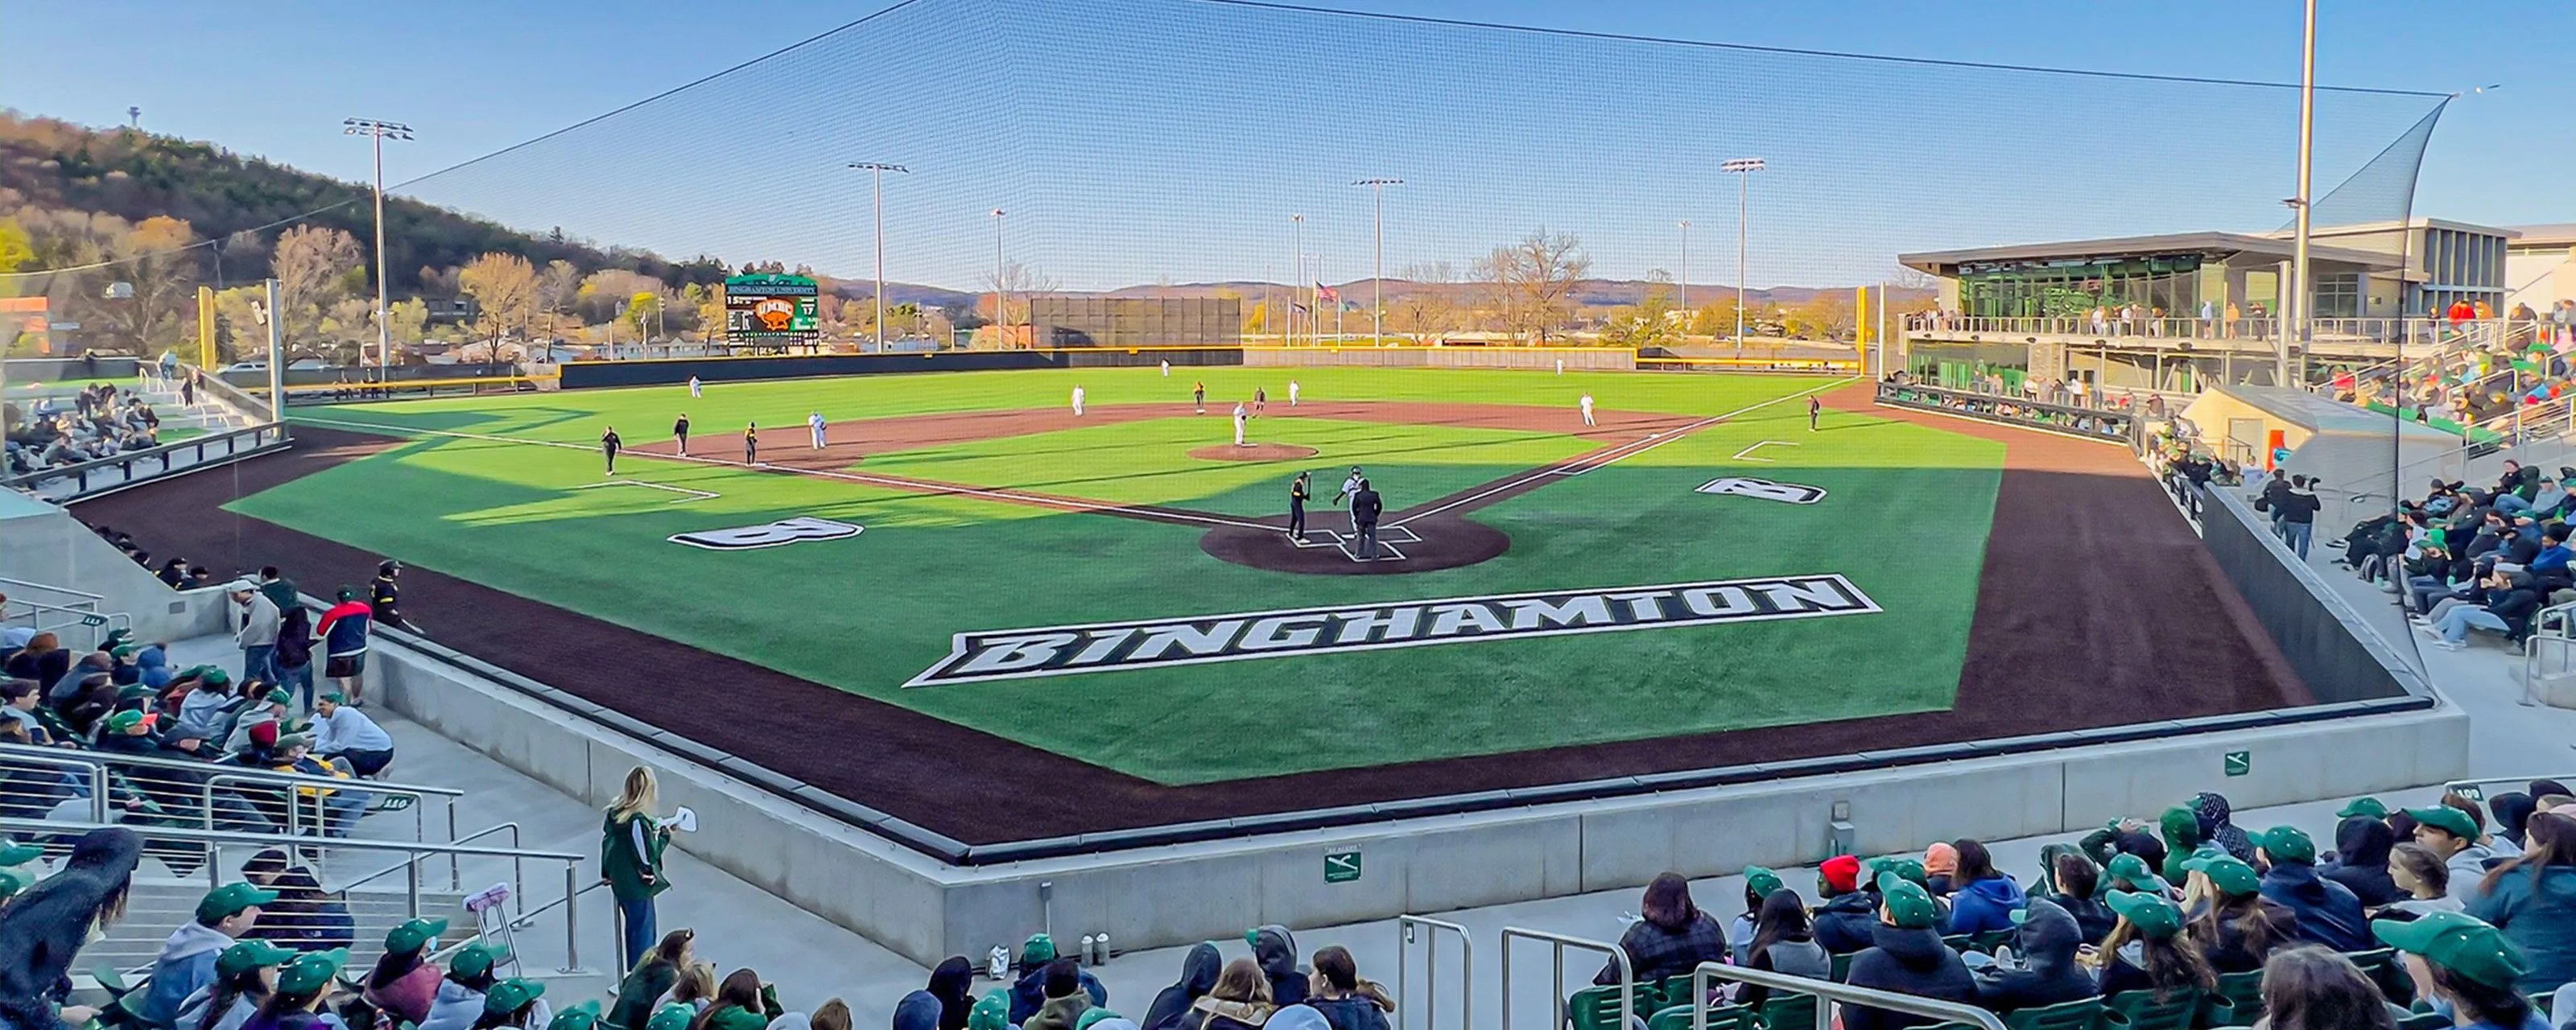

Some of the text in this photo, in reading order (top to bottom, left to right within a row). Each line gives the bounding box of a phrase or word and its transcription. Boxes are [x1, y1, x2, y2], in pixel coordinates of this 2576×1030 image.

[759, 302, 793, 316] UMBC
[943, 579, 1855, 676] BINGHAMTON
[383, 798, 407, 809] 110
